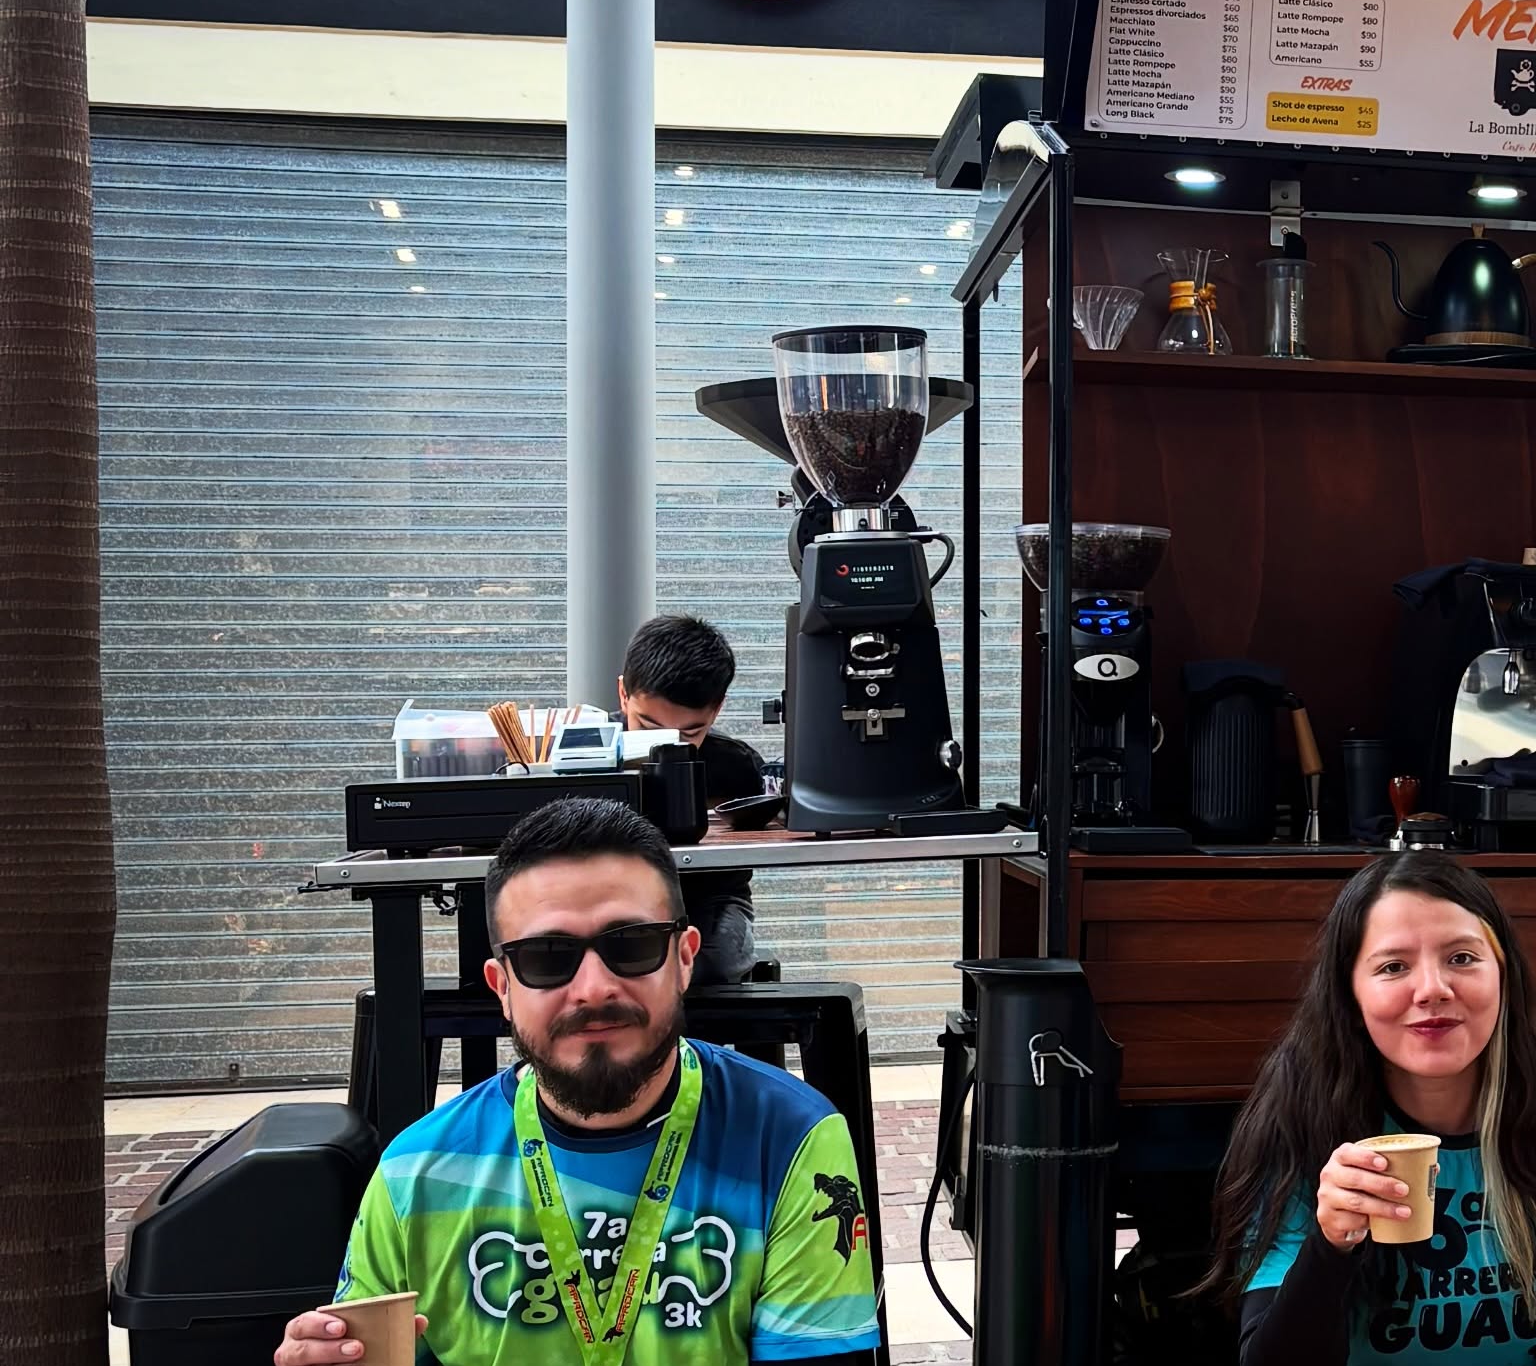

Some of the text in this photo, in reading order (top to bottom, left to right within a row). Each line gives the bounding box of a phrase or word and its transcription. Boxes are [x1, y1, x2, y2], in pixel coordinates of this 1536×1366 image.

[1152, 0, 1186, 7] cortado
[1303, 0, 1333, 8] Clásico
[1110, 6, 1153, 16] Espressos
[1156, 9, 1206, 19] divorciados
[1110, 17, 1155, 26] Macchiato
[1278, 12, 1299, 20] Latte
[1302, 13, 1343, 24] Rompope
[1109, 27, 1125, 35] Flat
[1128, 28, 1156, 37] White
[1277, 26, 1299, 34] Latte
[1301, 28, 1329, 36] Mocha
[1109, 37, 1161, 47] Cappuccino
[1300, 42, 1338, 51] Mazapán
[1109, 48, 1131, 56] Latte
[1133, 49, 1164, 58] Clásico
[1133, 60, 1176, 69] Rompope
[1275, 55, 1322, 64] Americano
[1108, 68, 1130, 76] Latte
[1132, 70, 1161, 78] Mocha
[1132, 80, 1171, 89] Mazapán
[1301, 76, 1352, 91] EXTRAS
[1107, 89, 1154, 98] Americano
[1157, 92, 1195, 101] Mediano
[1106, 99, 1154, 108] Americano
[1156, 102, 1188, 111] Grande
[1294, 102, 1305, 110] de
[1307, 104, 1344, 112] espresso
[1106, 110, 1128, 118] Long
[1131, 111, 1155, 119] Black
[1272, 115, 1297, 123] Leche
[1299, 116, 1310, 124] de
[1312, 117, 1338, 126] Avena
[1469, 121, 1484, 133] La
[665, 1302, 703, 1328] 3k
